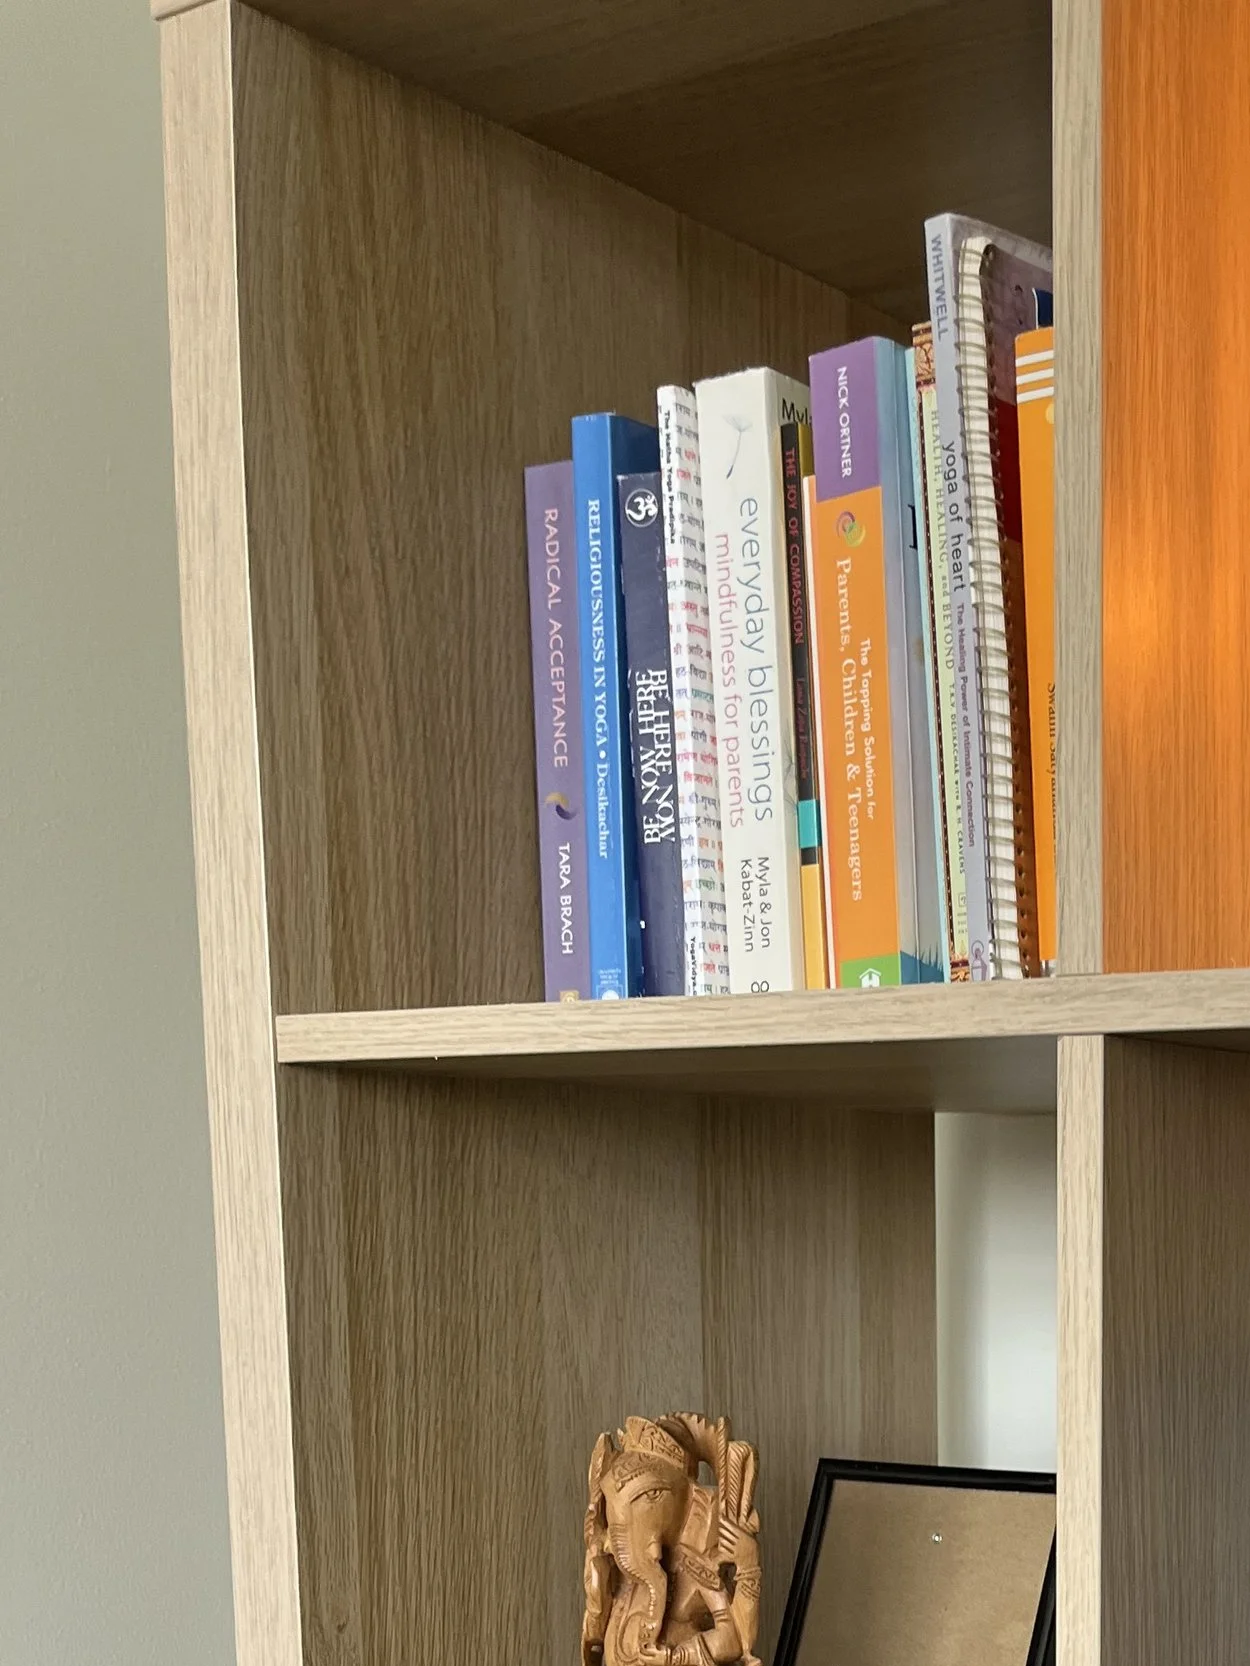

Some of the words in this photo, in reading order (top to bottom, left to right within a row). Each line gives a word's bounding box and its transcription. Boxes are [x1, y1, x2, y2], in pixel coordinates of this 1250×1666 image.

[930, 233, 950, 343] WHITWELL
[836, 366, 850, 415] NICK
[784, 448, 798, 478] THE
[839, 418, 853, 479] ORTNER
[941, 440, 958, 492] yoga
[786, 485, 799, 511] JOY
[788, 516, 800, 537] OF
[948, 502, 964, 525] of
[543, 508, 563, 610] RADICAL
[587, 499, 605, 668] RELIGIOUSNESS
[736, 497, 770, 654] everyday
[951, 533, 966, 592] heart
[713, 533, 738, 688] mindfulness
[789, 543, 805, 645] COMPASSION
[835, 556, 852, 653] Parents,
[956, 603, 964, 626] The
[592, 666, 607, 687] IN
[860, 638, 872, 667] The
[957, 629, 970, 674] Healing
[548, 618, 568, 768] ACCEPTANCE
[650, 669, 669, 700] BE
[723, 693, 743, 728] for
[841, 657, 860, 757] Children
[860, 668, 874, 734] Tapping
[960, 675, 970, 714] Power
[593, 687, 609, 747] YOGA
[653, 710, 673, 775] HERE
[747, 665, 776, 822] blessings
[962, 715, 970, 729] of
[846, 763, 862, 782] &
[863, 736, 877, 798] Solution
[962, 730, 973, 777] Intimate
[596, 762, 610, 860] Desikachar
[721, 737, 746, 829] parents
[866, 801, 876, 820] for
[656, 784, 676, 842] NOW
[965, 780, 975, 848] Connection
[558, 842, 571, 890] TARA
[847, 787, 863, 902] Teenagers
[740, 858, 756, 953] Kabat-Zinn
[757, 856, 771, 897] Myla
[560, 894, 574, 955] BRACH
[758, 902, 772, 913] &
[758, 918, 772, 949] Jon
